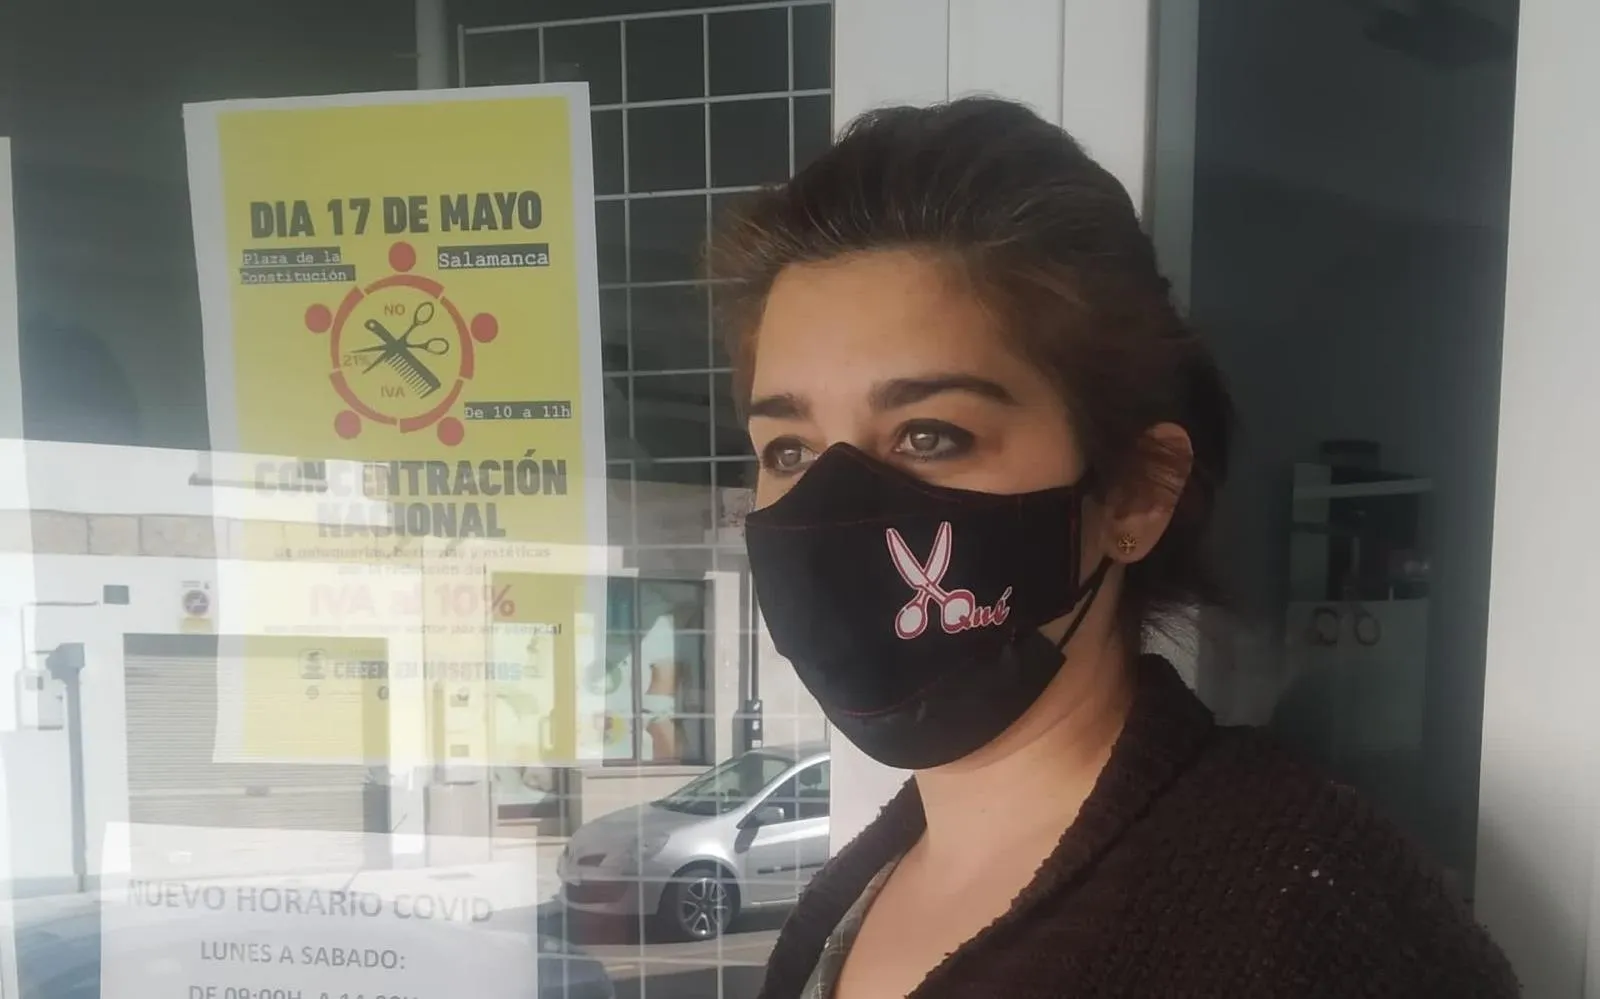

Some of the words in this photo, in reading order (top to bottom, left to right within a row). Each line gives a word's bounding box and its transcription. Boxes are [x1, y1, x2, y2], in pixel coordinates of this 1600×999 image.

[250, 200, 316, 239] DIA
[327, 197, 371, 236] 17
[383, 195, 429, 234] DE
[440, 190, 543, 232] MAYO
[243, 252, 288, 265] Plaza
[296, 252, 315, 264] de
[324, 251, 341, 263] la
[438, 249, 550, 268] Salamanca
[242, 268, 348, 282] Constitución
[384, 303, 406, 317] NO
[380, 385, 406, 398] IVA
[464, 406, 484, 419] De
[494, 405, 512, 418] 10
[523, 408, 532, 418] a
[543, 405, 571, 418] 11h
[254, 448, 568, 497] CONCENTRACIÓN
[317, 502, 506, 538] NACIONAL
[310, 584, 377, 618] IVA
[433, 582, 516, 618] 10%
[127, 879, 226, 911] NUEVO
[393, 893, 494, 923] COVID
[200, 940, 272, 963] LUNES
[278, 945, 295, 965] A
[301, 946, 406, 970] SABADO:
